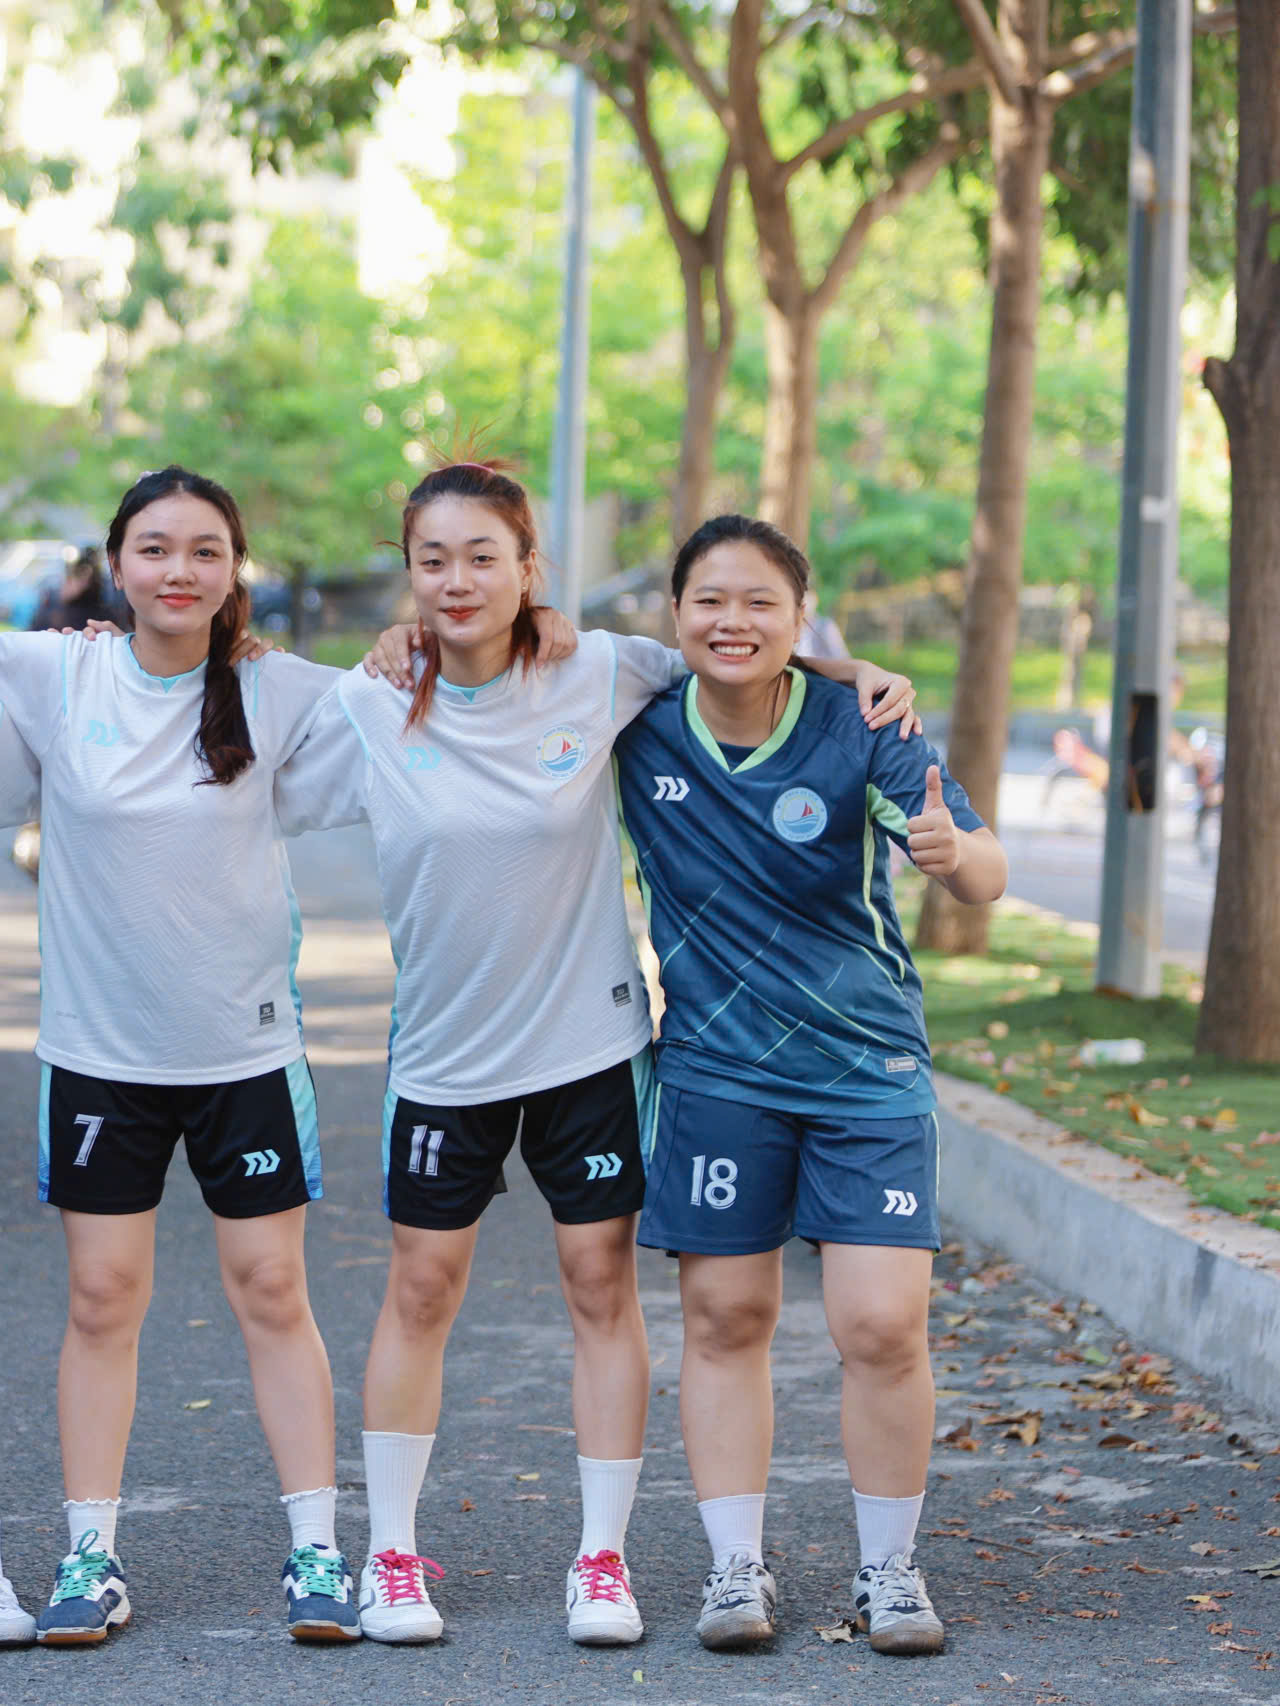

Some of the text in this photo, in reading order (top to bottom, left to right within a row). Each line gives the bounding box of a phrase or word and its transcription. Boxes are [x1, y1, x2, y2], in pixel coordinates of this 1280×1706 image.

[73, 1114, 104, 1166] 7
[408, 1125, 444, 1176] 11
[691, 1155, 738, 1209] 18
